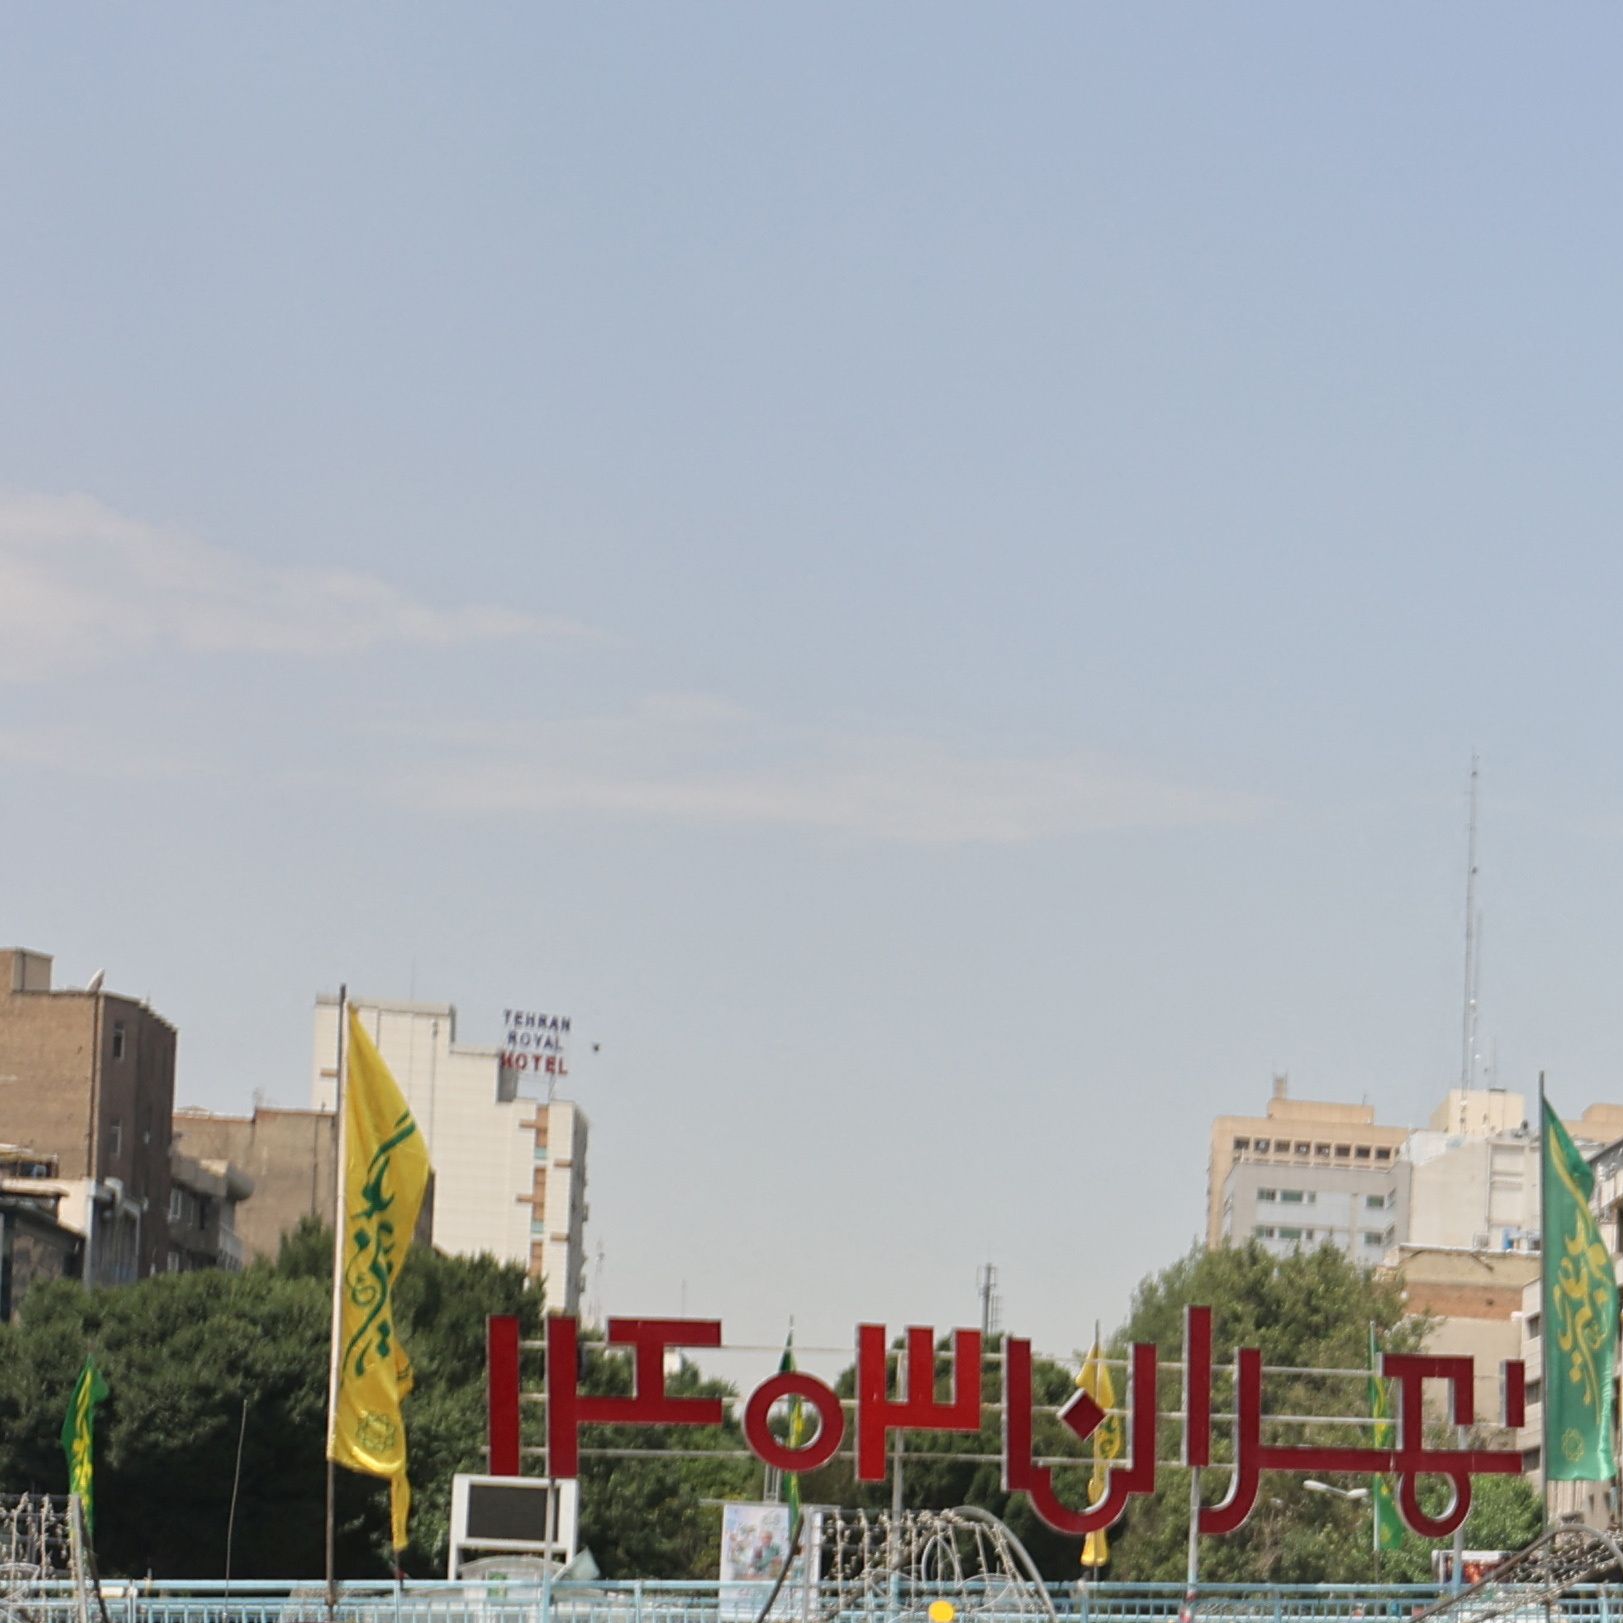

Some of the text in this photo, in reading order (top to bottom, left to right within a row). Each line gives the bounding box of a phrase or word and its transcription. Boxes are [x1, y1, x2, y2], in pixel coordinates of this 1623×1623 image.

[504, 1009, 571, 1031] TEHRAN
[508, 1030, 562, 1051] ROYAL
[500, 1052, 568, 1075] HOTEL
